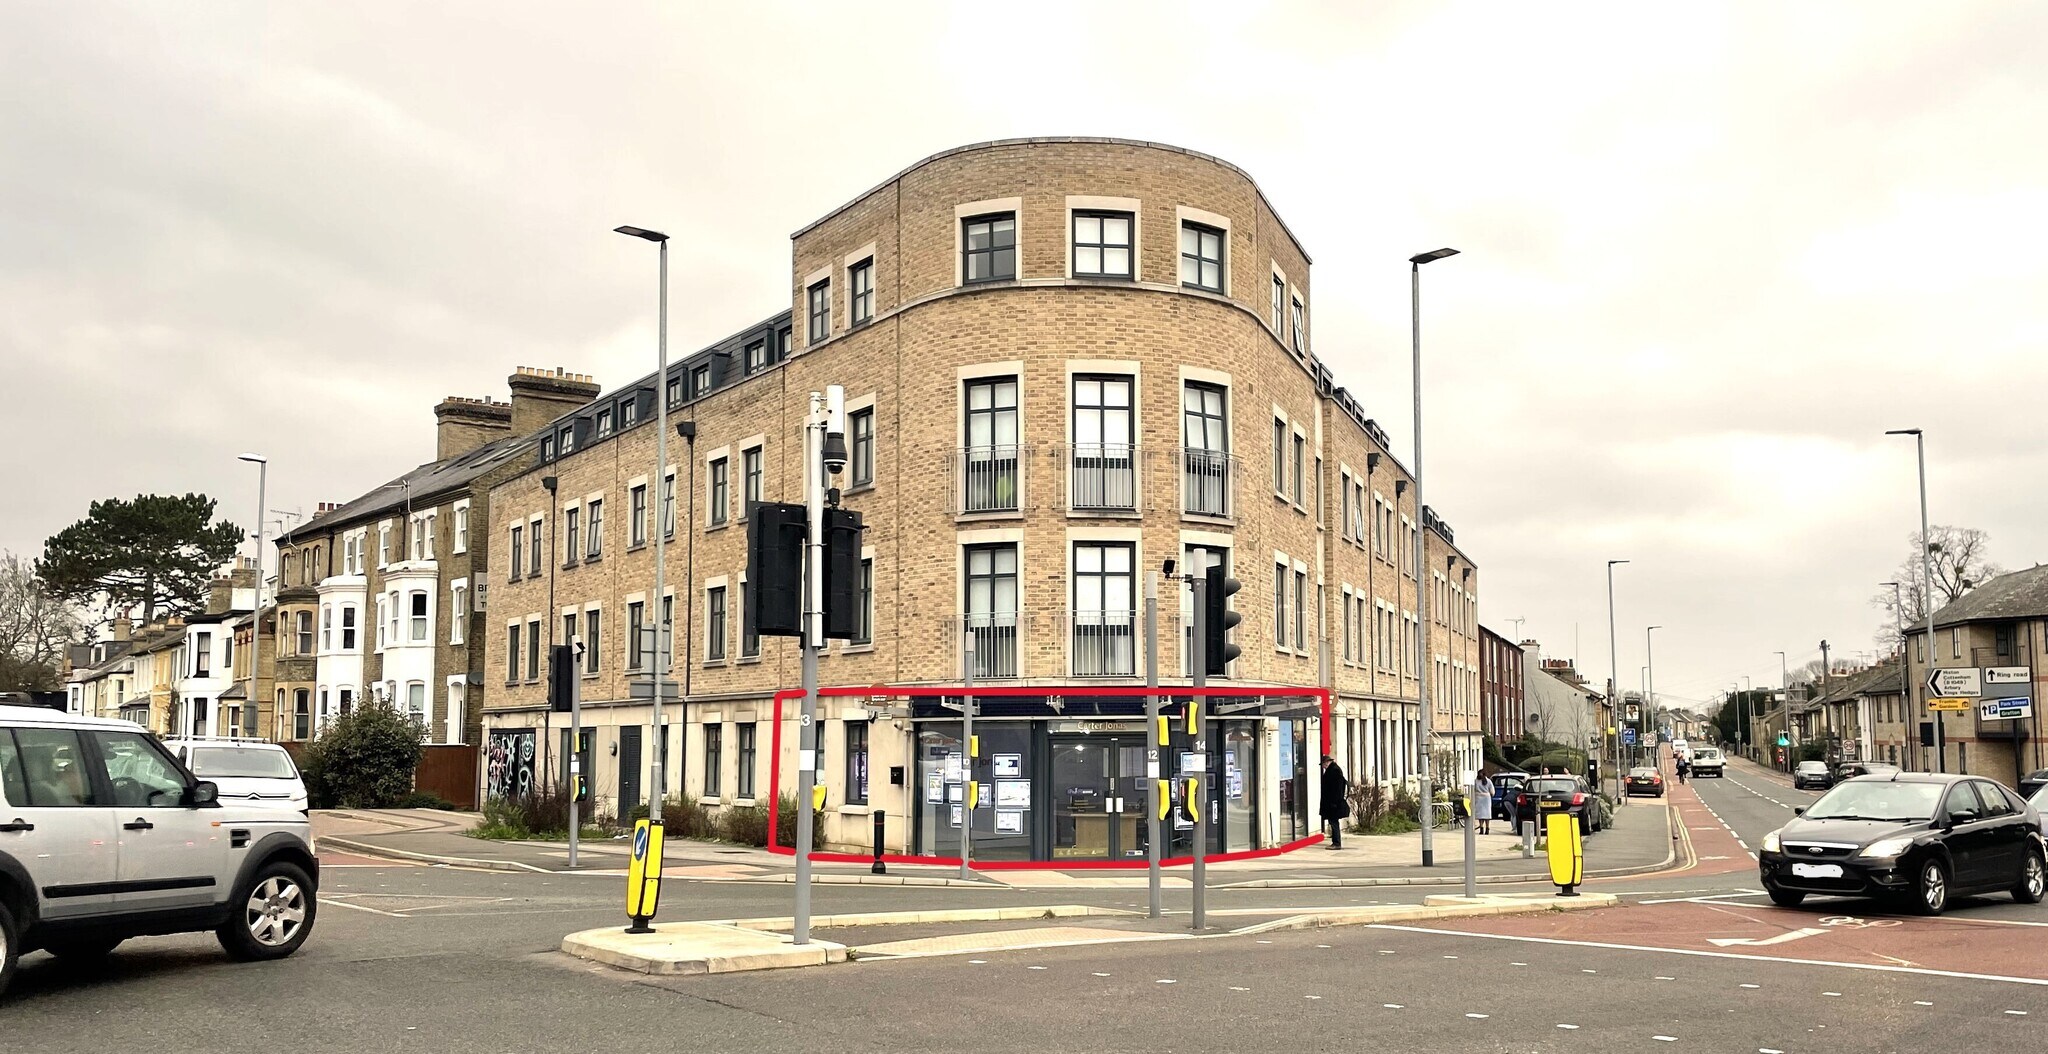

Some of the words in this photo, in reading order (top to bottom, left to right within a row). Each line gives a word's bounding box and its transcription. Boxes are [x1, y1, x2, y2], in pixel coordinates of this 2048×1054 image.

[1990, 706, 1997, 714] P
[1077, 721, 1103, 730] Carter
[1104, 721, 1127, 731] Jonas
[1195, 740, 1206, 751] 14
[1147, 750, 1158, 760] 12
